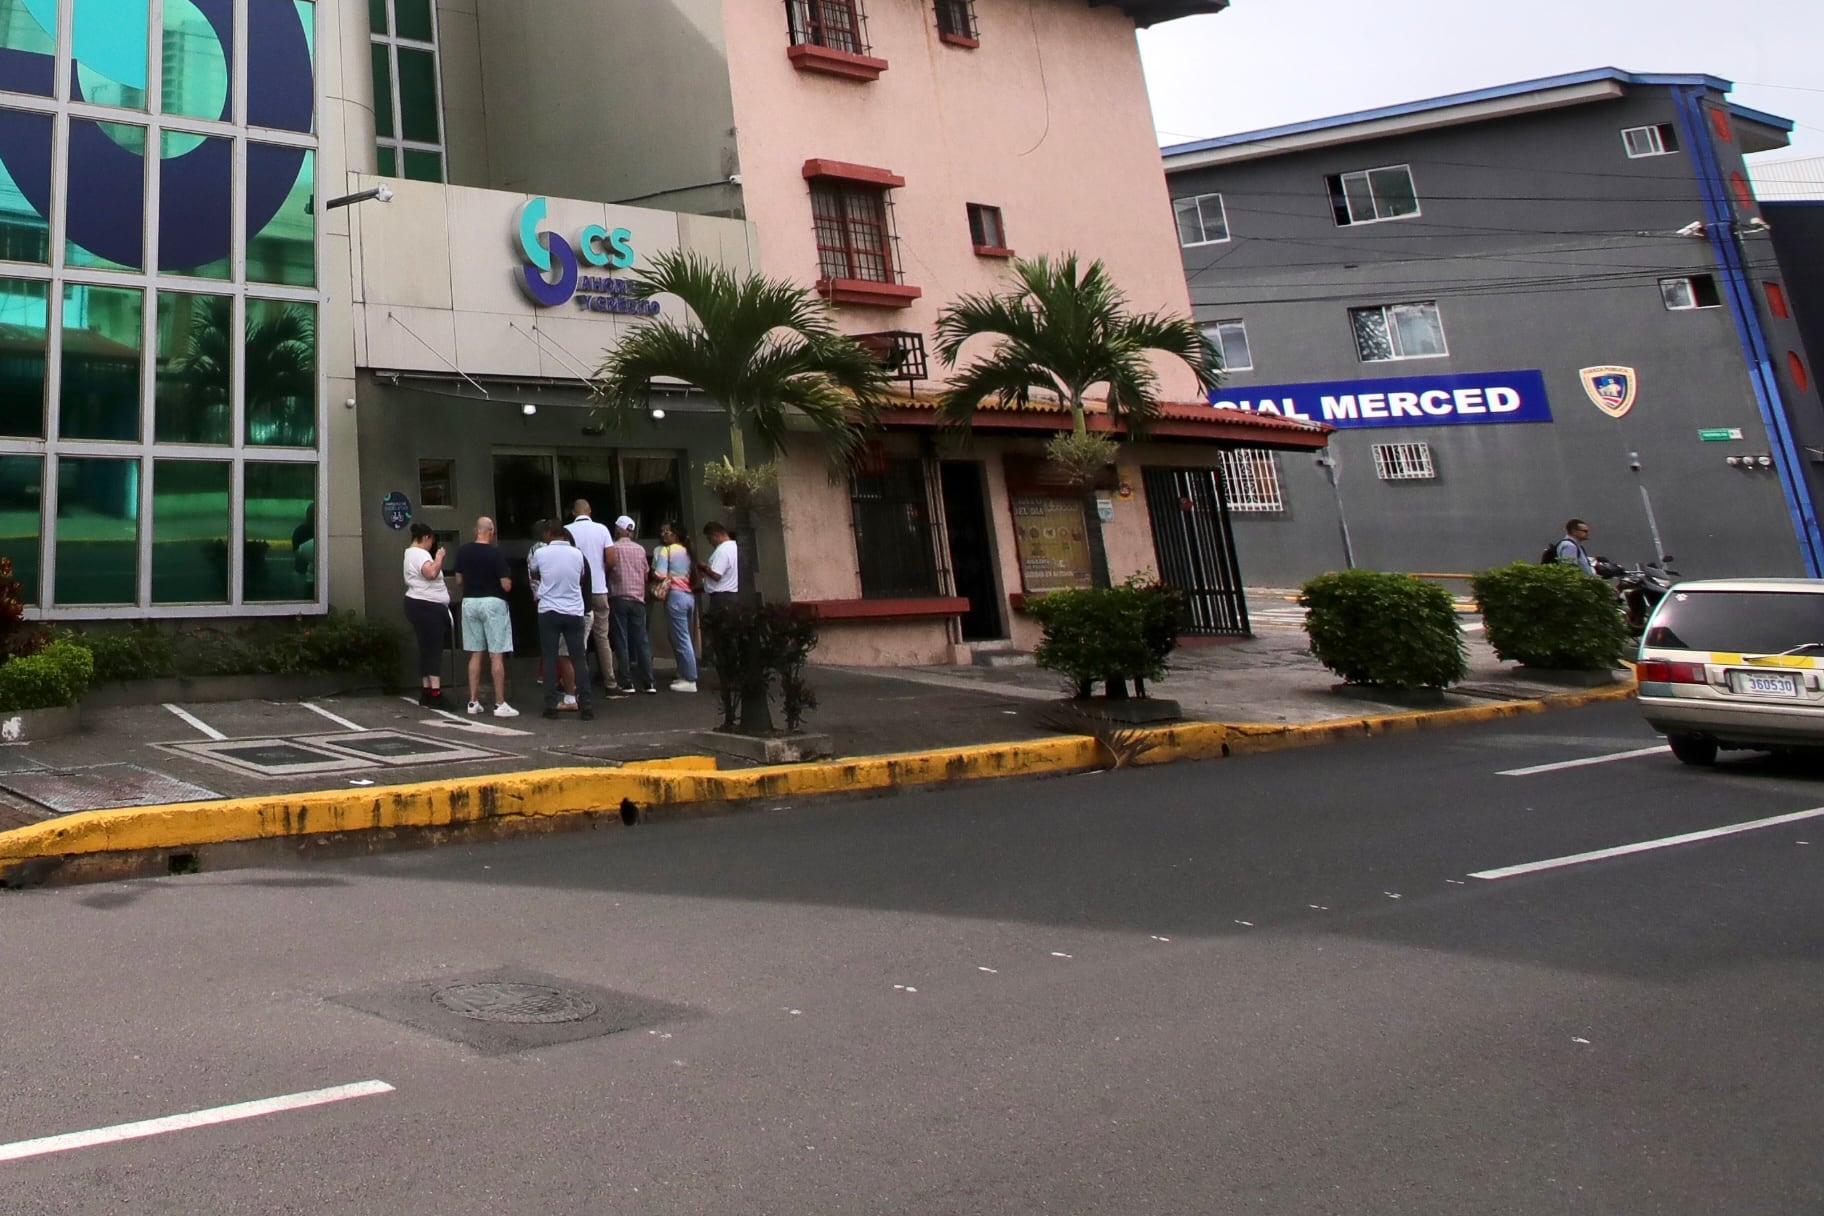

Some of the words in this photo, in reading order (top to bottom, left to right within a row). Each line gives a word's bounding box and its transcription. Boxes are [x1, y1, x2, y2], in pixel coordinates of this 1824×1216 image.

[580, 224, 636, 269] CS
[580, 275, 640, 295] AHOR
[1320, 387, 1521, 421] MERCED
[1749, 678, 1792, 692] 360530
